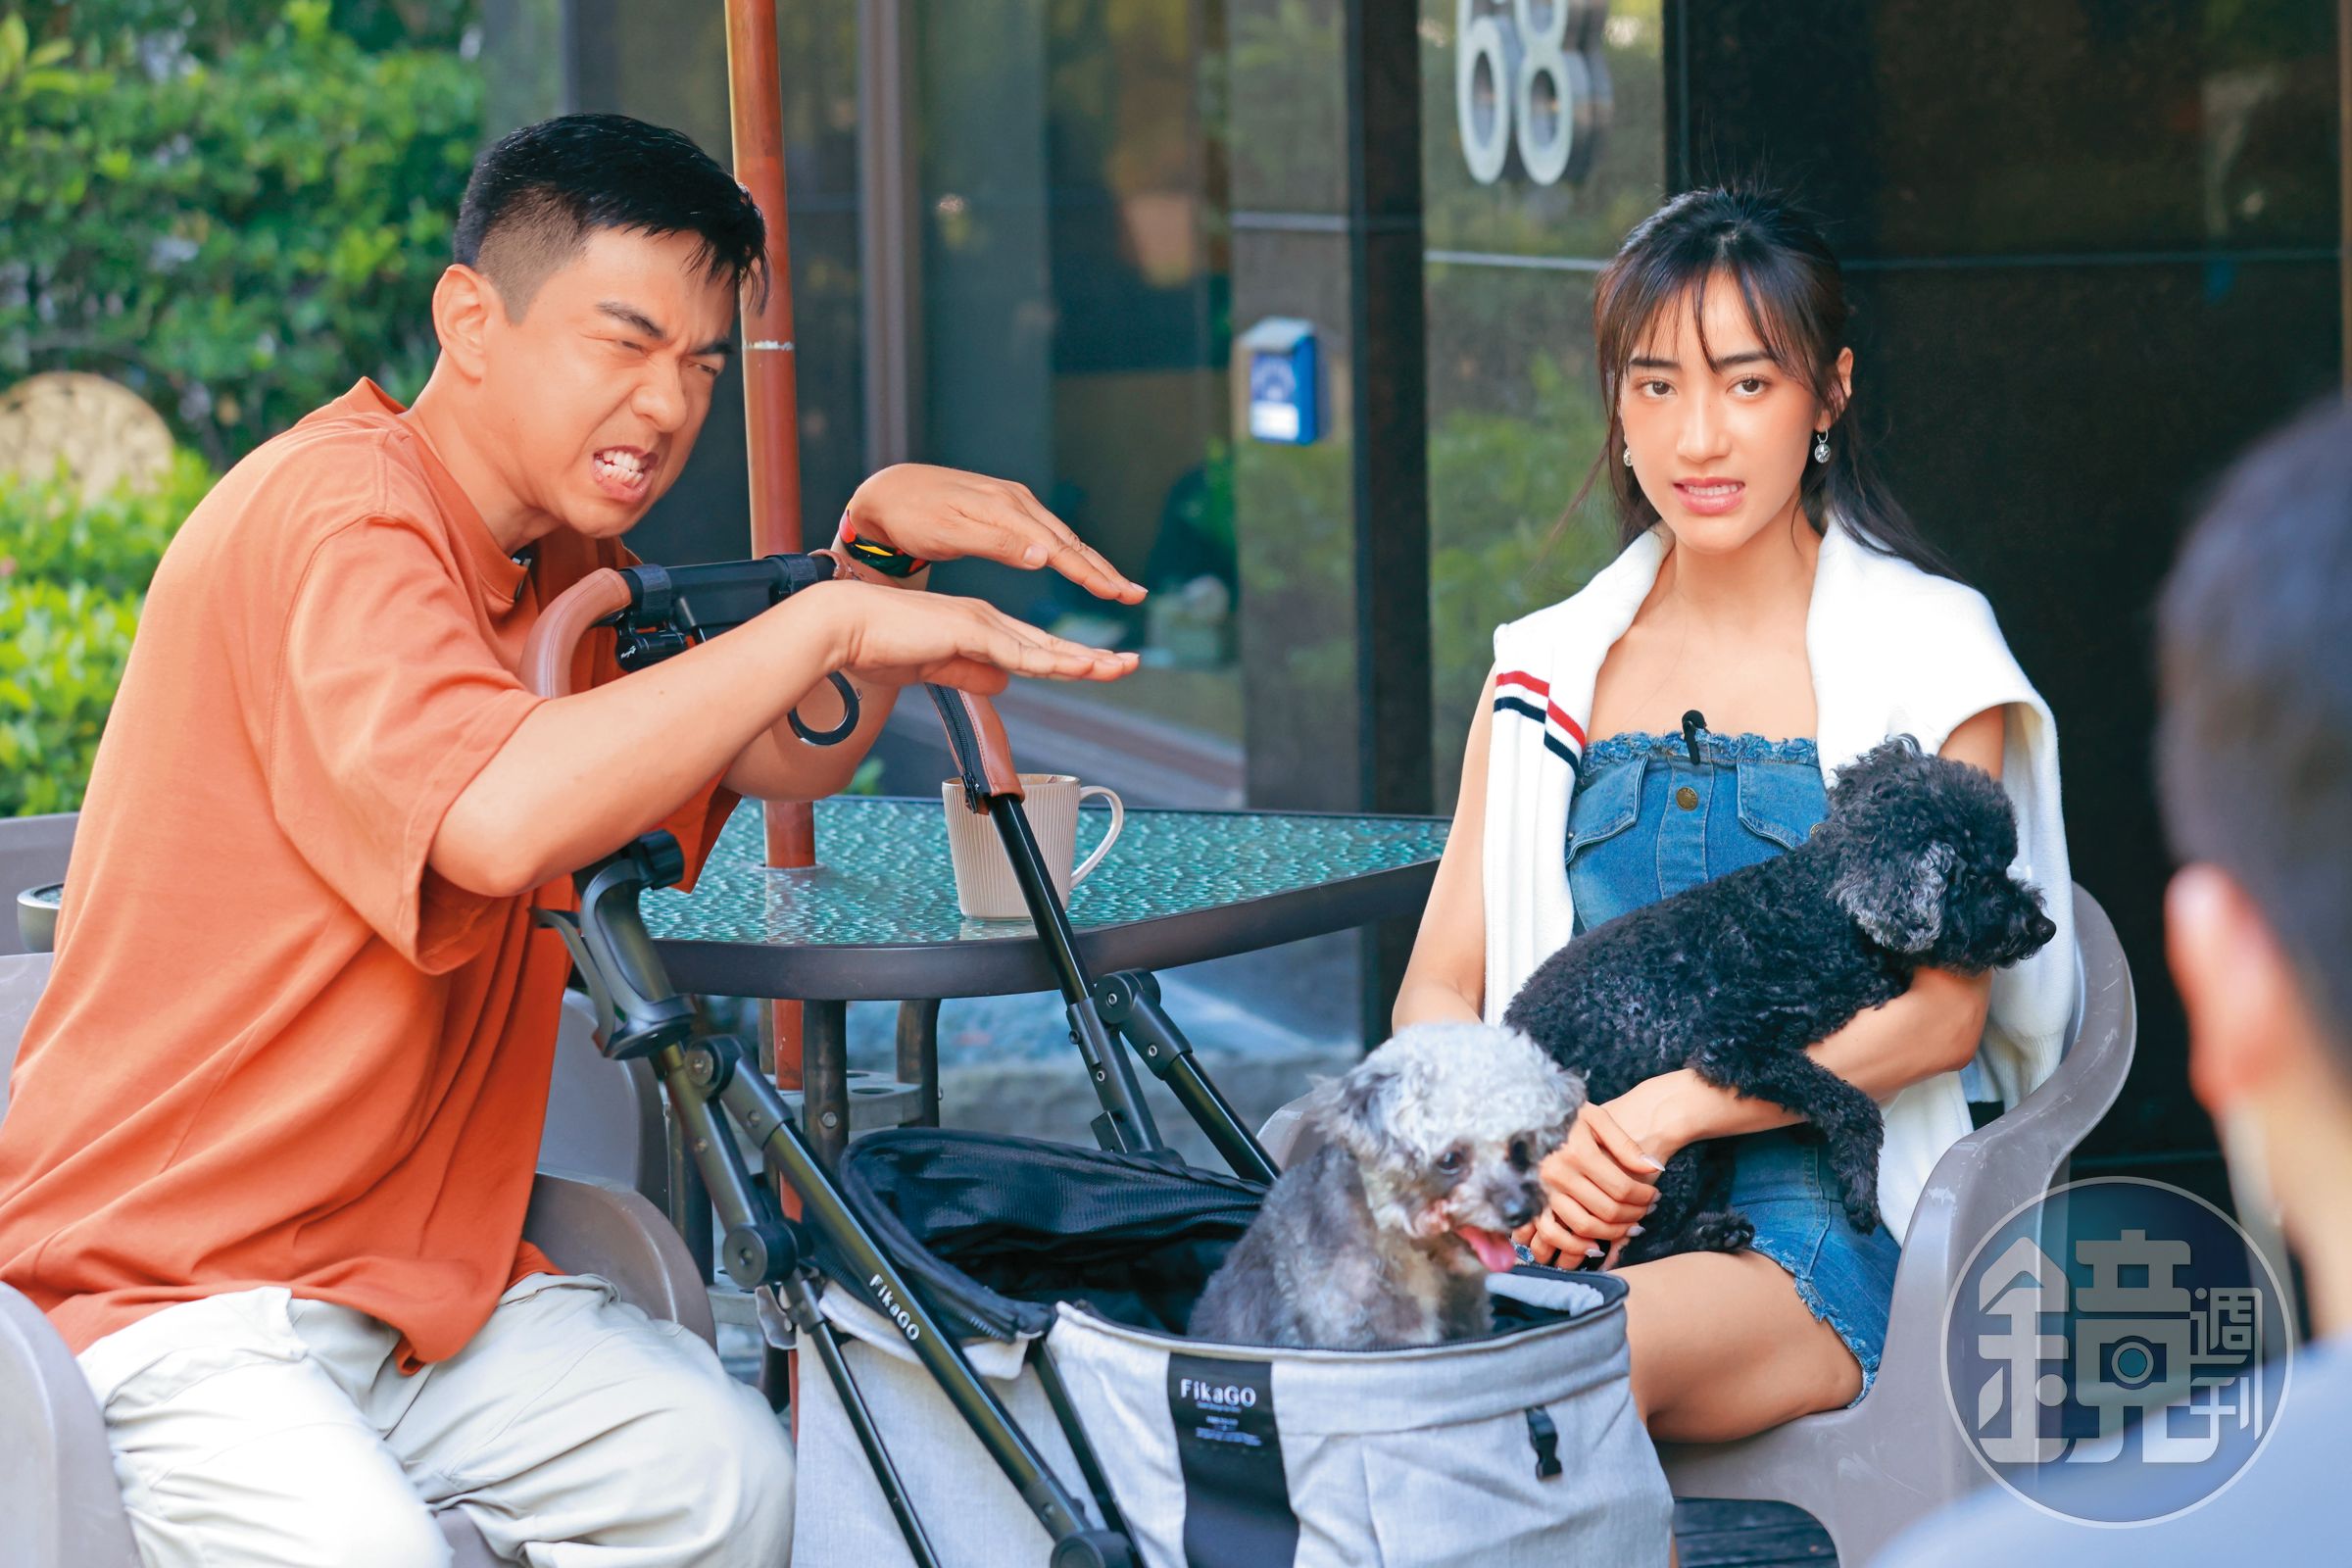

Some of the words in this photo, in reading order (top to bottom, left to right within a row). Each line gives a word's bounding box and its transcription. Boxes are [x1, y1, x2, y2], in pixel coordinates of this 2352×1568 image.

[1455, 0, 1573, 186] 68
[869, 1274, 920, 1341] FikaGO
[1180, 1378, 1256, 1408] FikaGO
